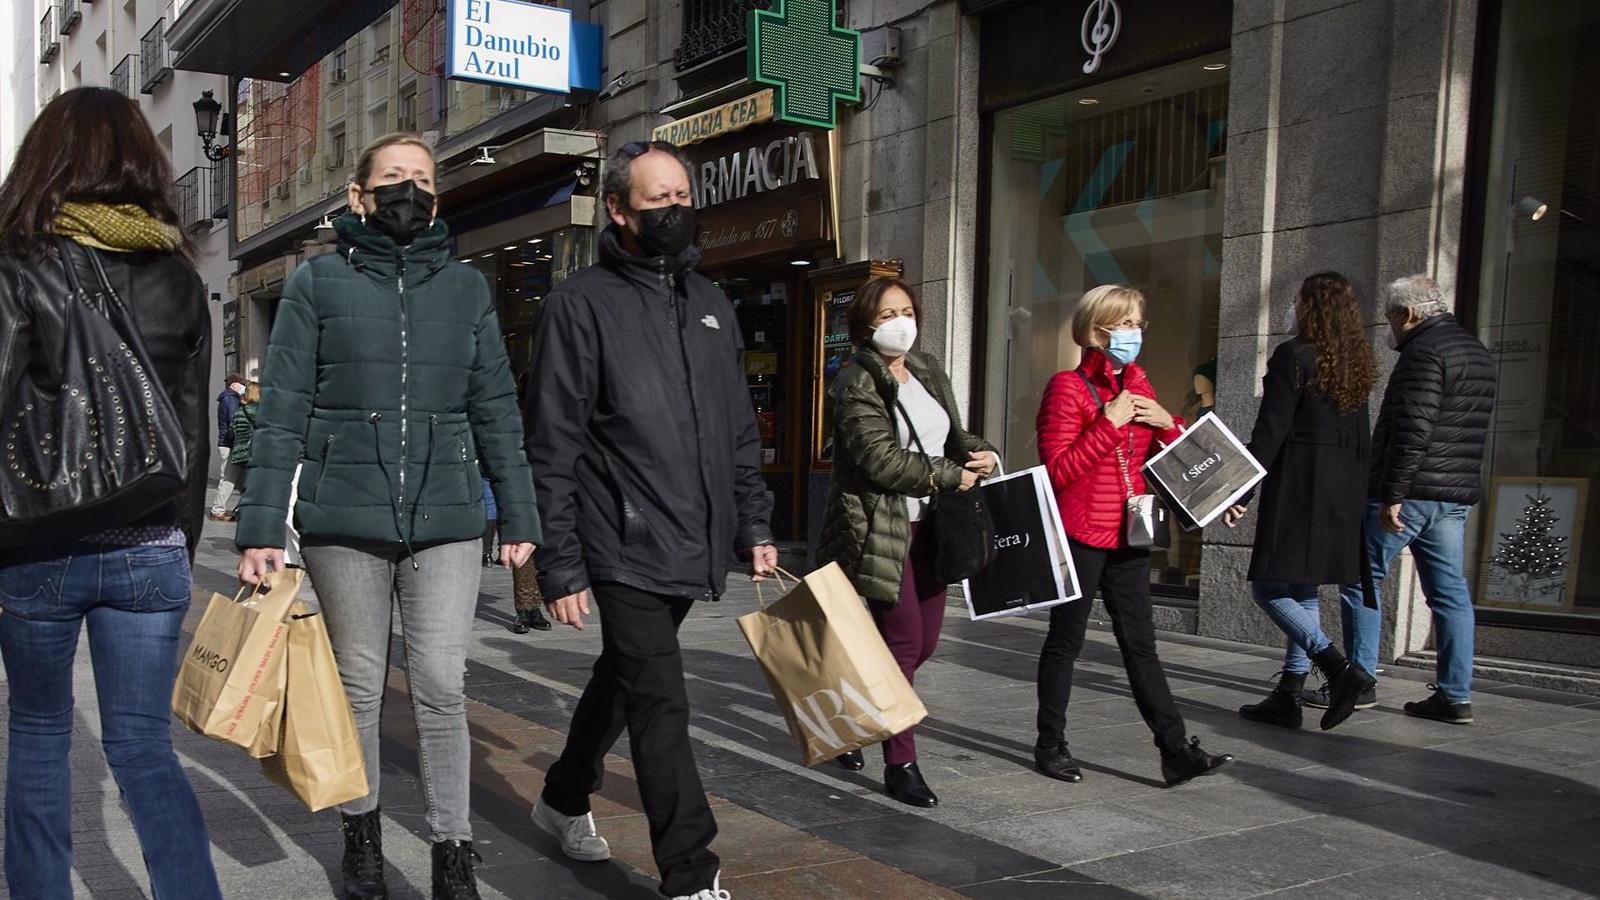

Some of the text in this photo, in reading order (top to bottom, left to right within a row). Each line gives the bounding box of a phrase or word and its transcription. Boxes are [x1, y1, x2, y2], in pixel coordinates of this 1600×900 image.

[465, 0, 491, 24] El
[465, 24, 561, 61] Danubio
[464, 51, 520, 80] Azul
[655, 97, 758, 144] FARMACIA CEA
[690, 131, 820, 210] ARMACIA
[192, 644, 229, 674] MANGO
[793, 677, 891, 757] ARA
